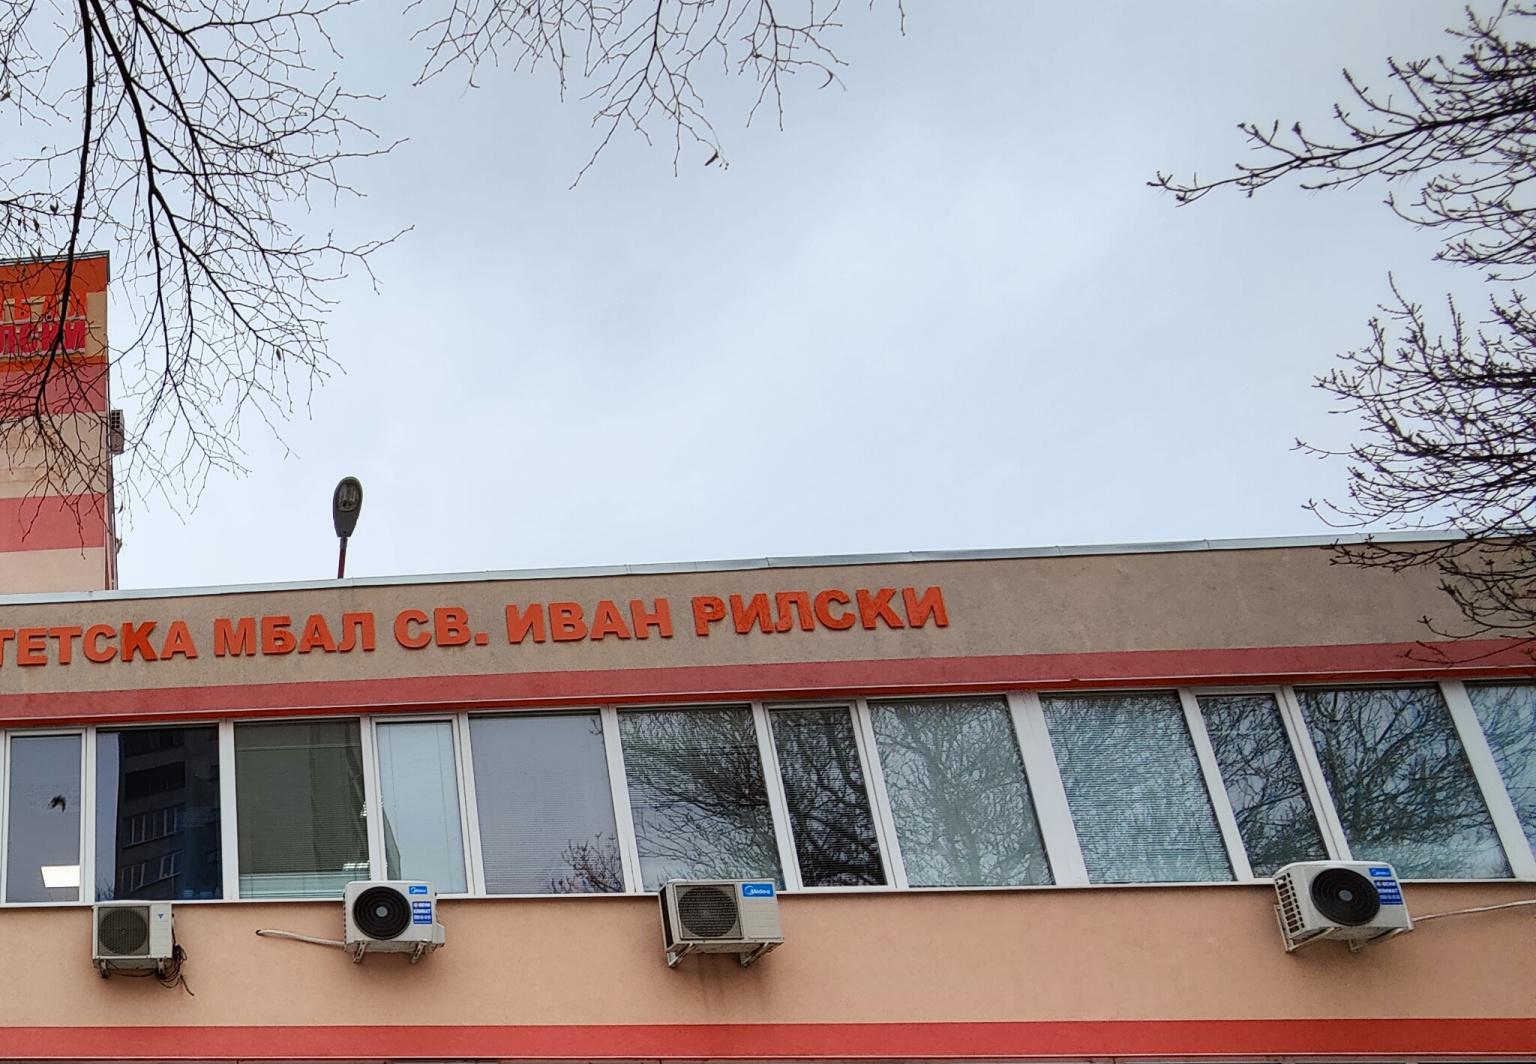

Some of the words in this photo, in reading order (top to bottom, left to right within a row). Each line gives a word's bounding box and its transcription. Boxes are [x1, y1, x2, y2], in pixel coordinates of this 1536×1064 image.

[214, 611, 376, 657] МБАЛ
[394, 606, 489, 648] СВ.
[505, 597, 674, 644] ИВАН
[691, 586, 949, 637] РИЛСКИ
